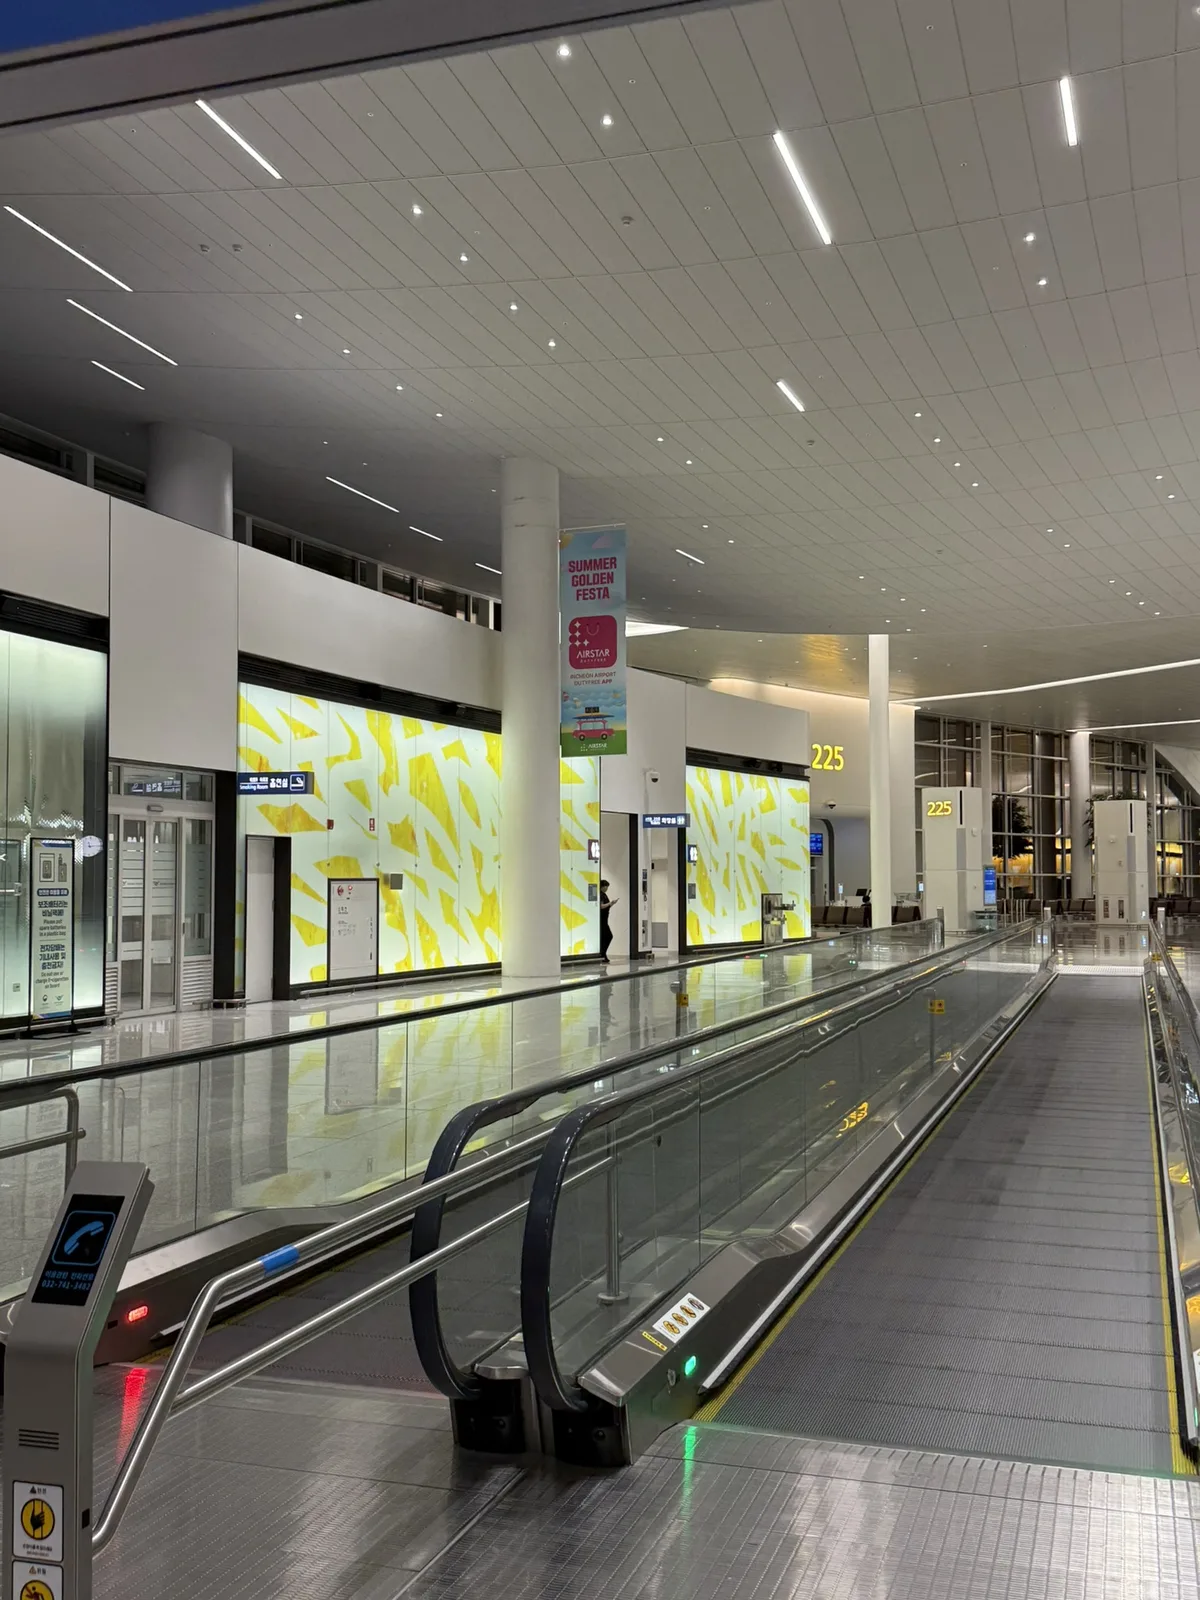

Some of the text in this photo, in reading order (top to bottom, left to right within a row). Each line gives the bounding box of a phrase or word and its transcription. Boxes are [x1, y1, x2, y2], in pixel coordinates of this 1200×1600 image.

[568, 557, 617, 573] SUMMER
[571, 571, 614, 588] GOLDEN
[576, 586, 610, 602] FESTA
[576, 648, 610, 659] AIRSTAR
[812, 743, 845, 771] 225
[269, 777, 289, 789] 흡연실
[927, 800, 952, 817] 225
